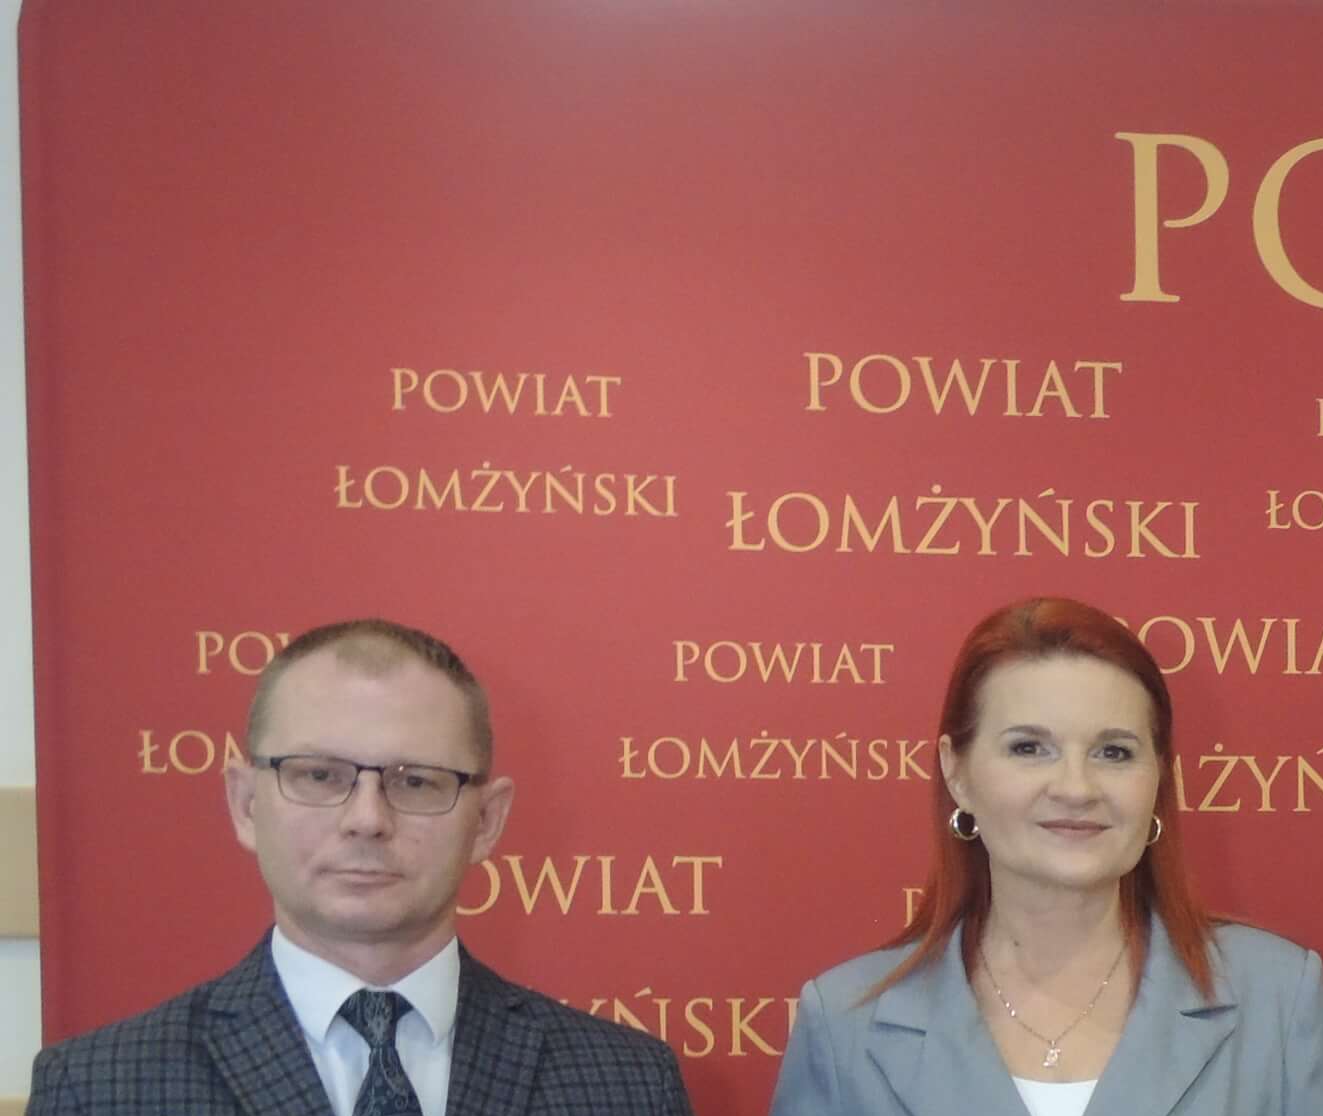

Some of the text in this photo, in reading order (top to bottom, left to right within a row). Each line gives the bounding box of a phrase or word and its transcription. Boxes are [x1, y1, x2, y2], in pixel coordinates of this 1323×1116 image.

[390, 367, 623, 418] POWIAT
[803, 351, 1122, 419] POWIAT
[334, 463, 678, 518] ŁOMŻYŃSKI
[726, 484, 1200, 560] ŁOMŻYŃSKI
[672, 639, 896, 688] POWIAT
[619, 729, 932, 780] ŁOMŻYŃSK
